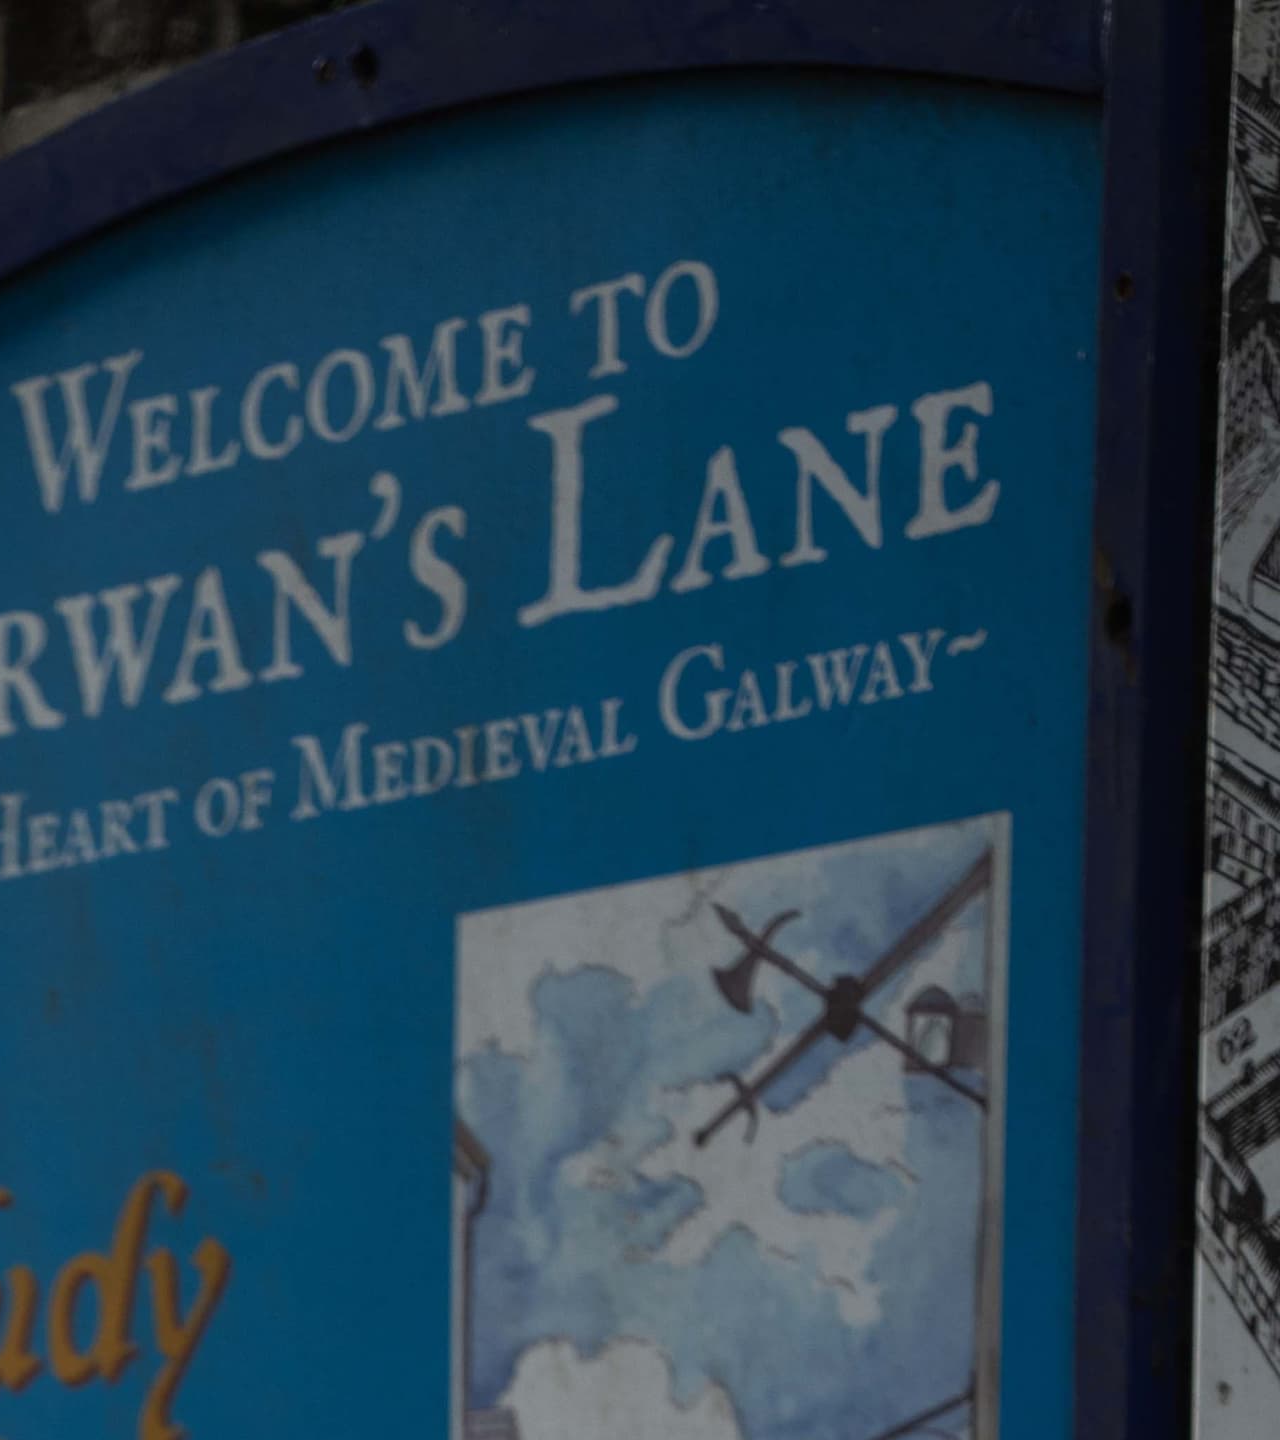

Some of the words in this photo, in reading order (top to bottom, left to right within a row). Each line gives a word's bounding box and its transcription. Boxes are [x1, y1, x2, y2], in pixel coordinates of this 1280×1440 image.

[10, 302, 537, 515] WELCOME
[569, 259, 720, 379] TO
[517, 380, 1001, 628] LANE
[193, 767, 277, 838] OF
[288, 697, 640, 823] MEDIEVAL
